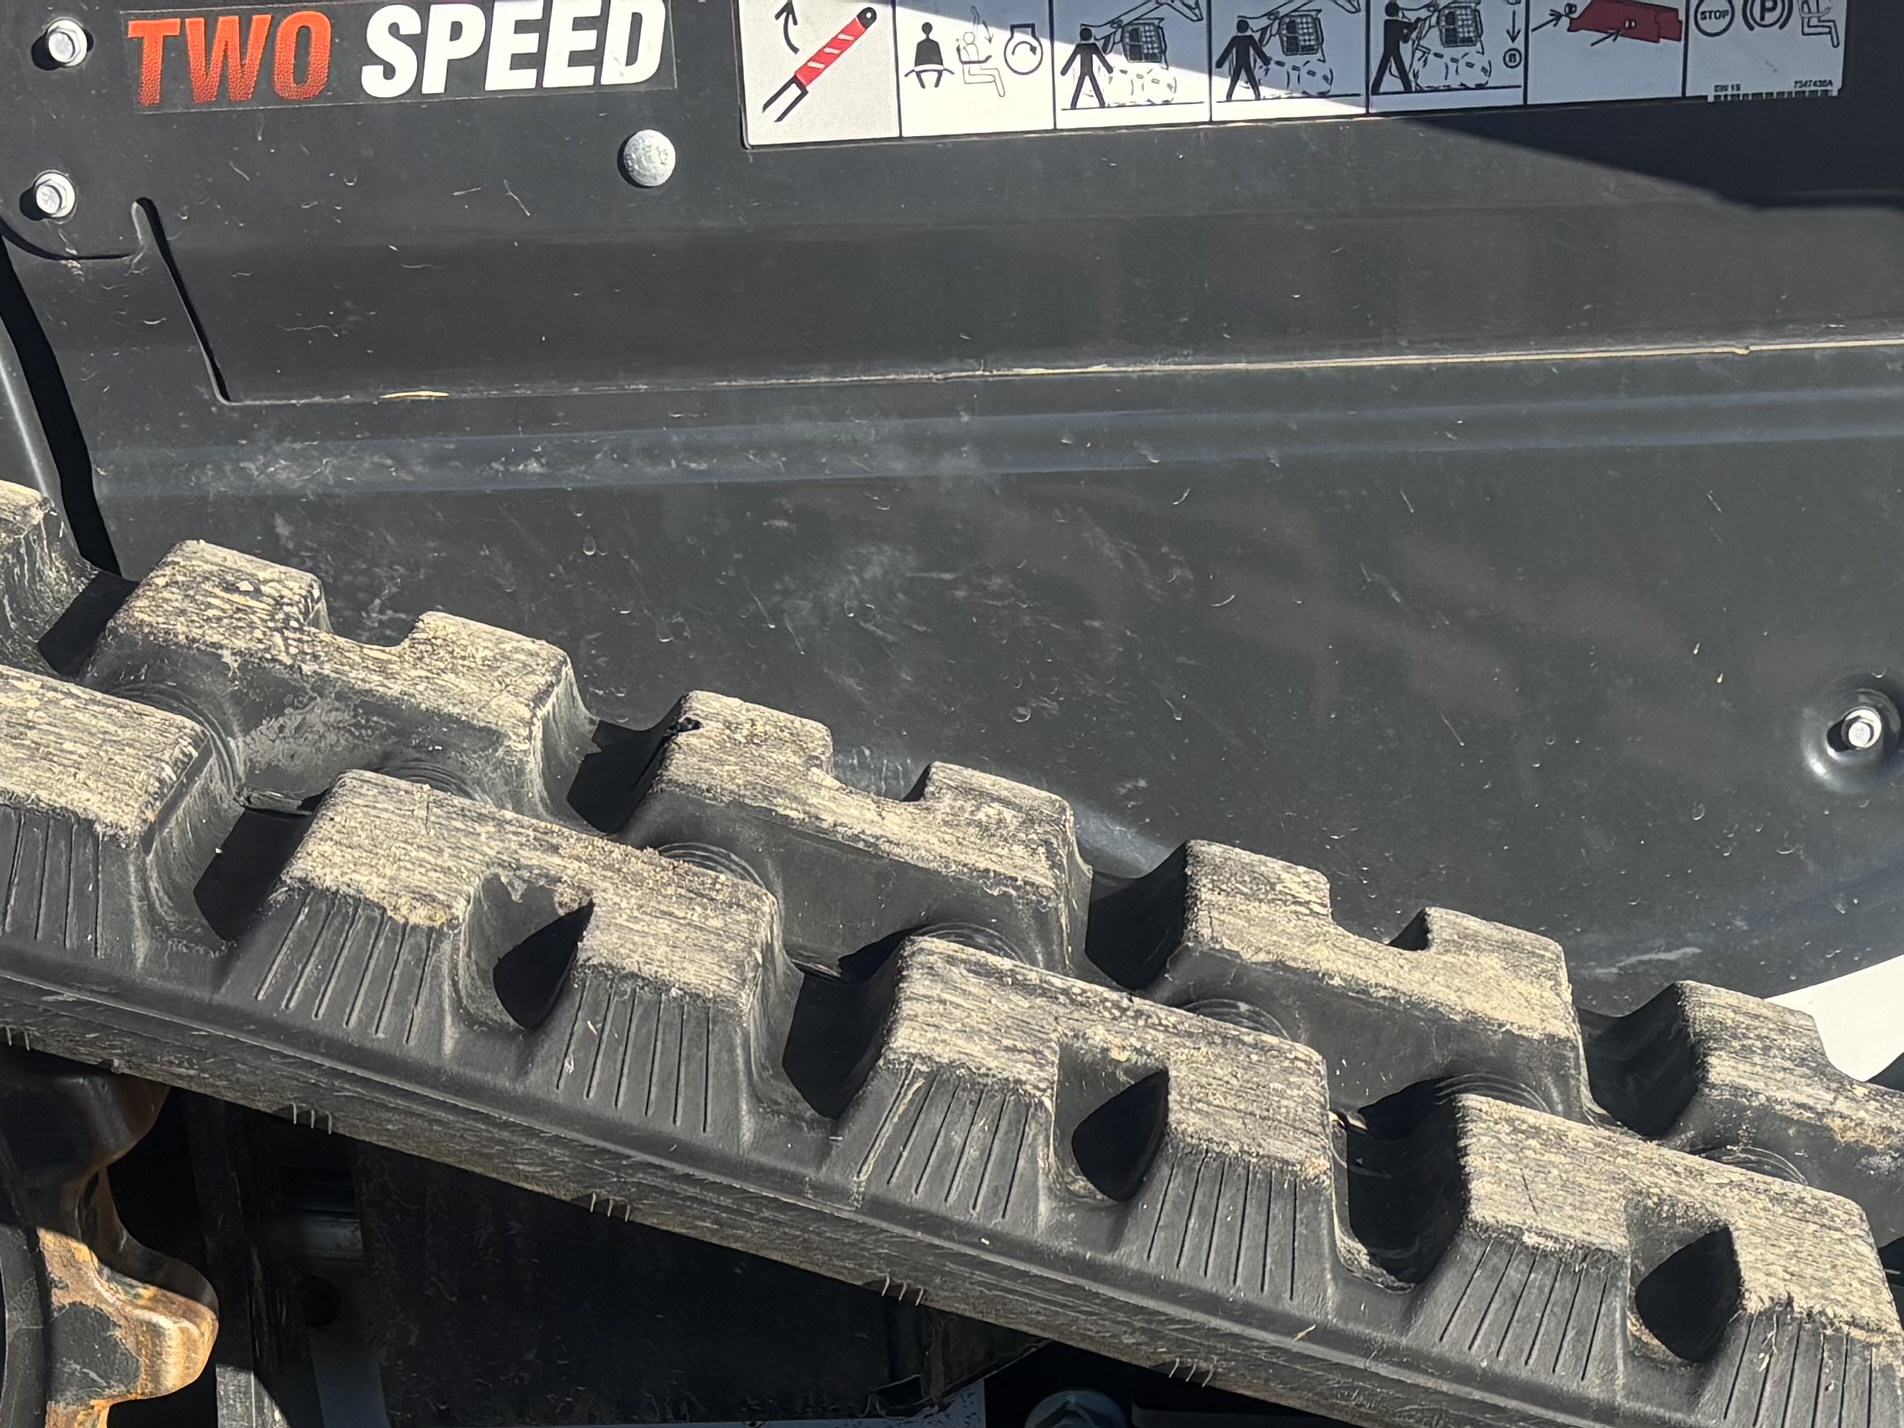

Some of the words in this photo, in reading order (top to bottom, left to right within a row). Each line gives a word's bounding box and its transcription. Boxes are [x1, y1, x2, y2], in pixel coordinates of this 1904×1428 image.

[1700, 8, 1730, 21] STOP
[127, 10, 332, 105] TWO
[361, 0, 666, 98] SPEED
